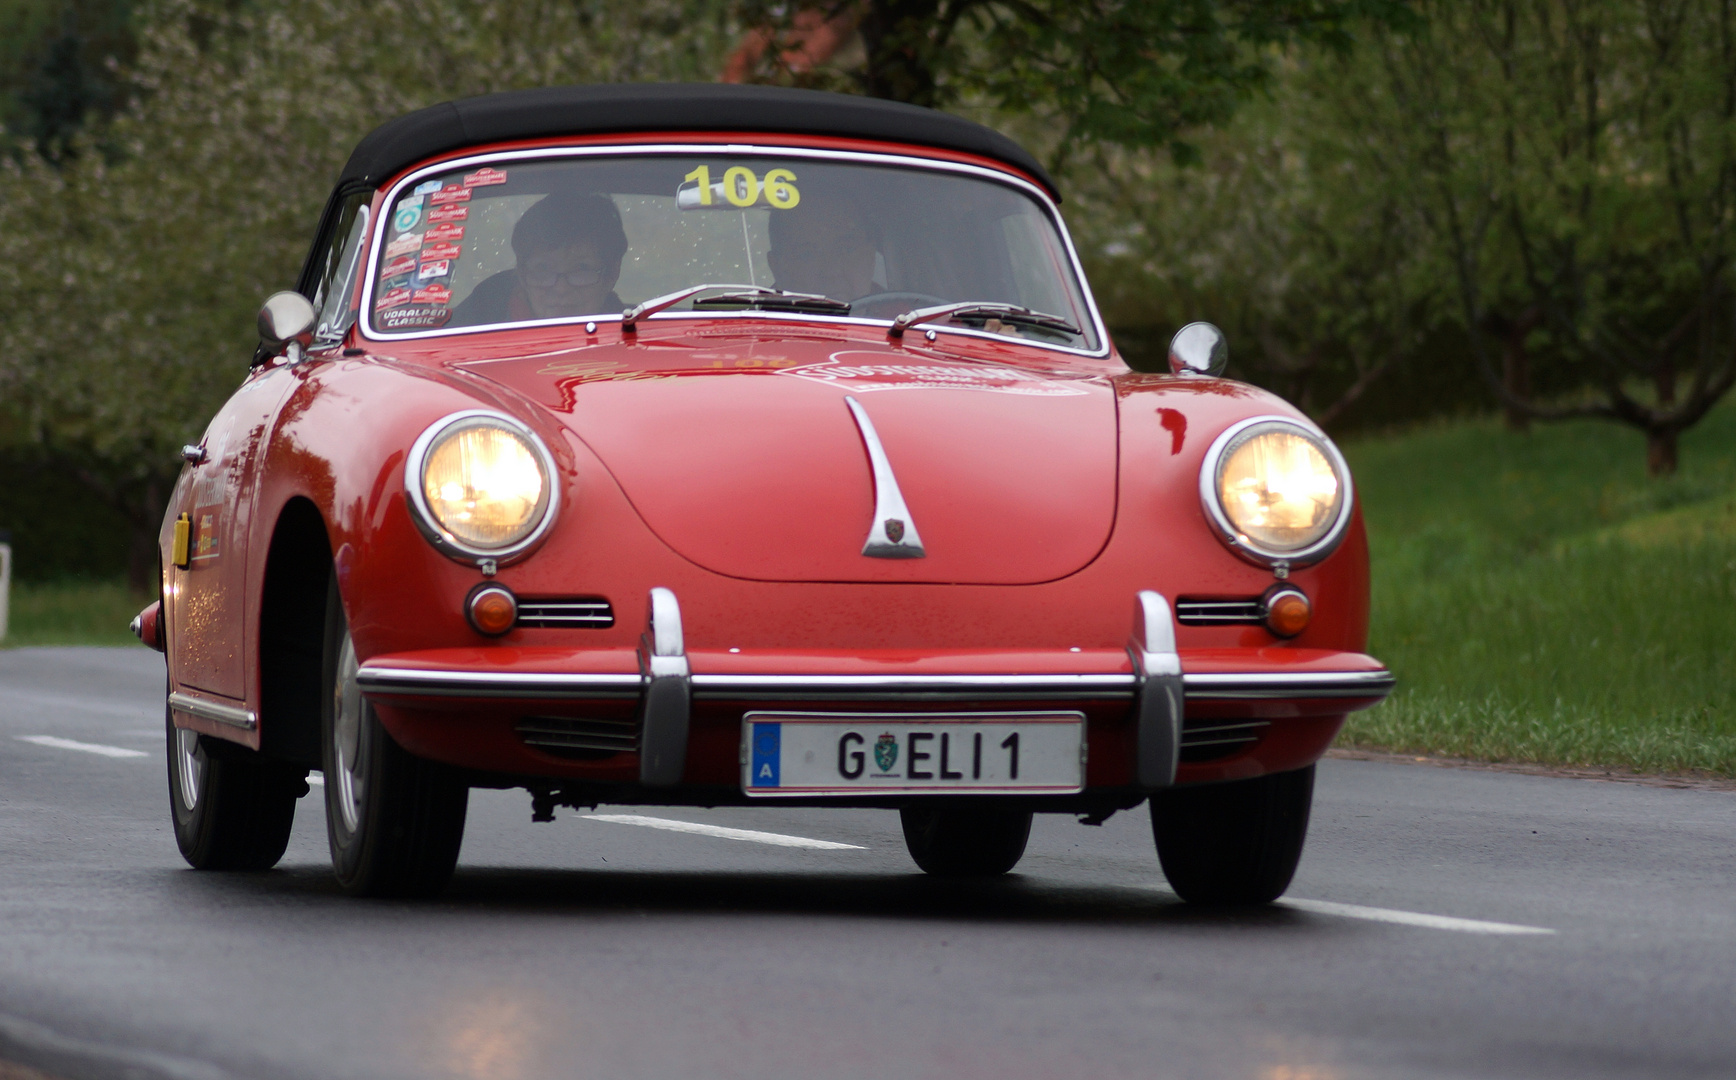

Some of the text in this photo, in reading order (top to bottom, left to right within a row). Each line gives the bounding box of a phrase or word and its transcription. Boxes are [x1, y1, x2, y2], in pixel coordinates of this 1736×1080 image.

[685, 165, 800, 209] 106
[383, 309, 447, 319] VORALPEN
[387, 317, 436, 327] CLASSIC
[838, 732, 865, 780] G
[759, 763, 774, 778] A
